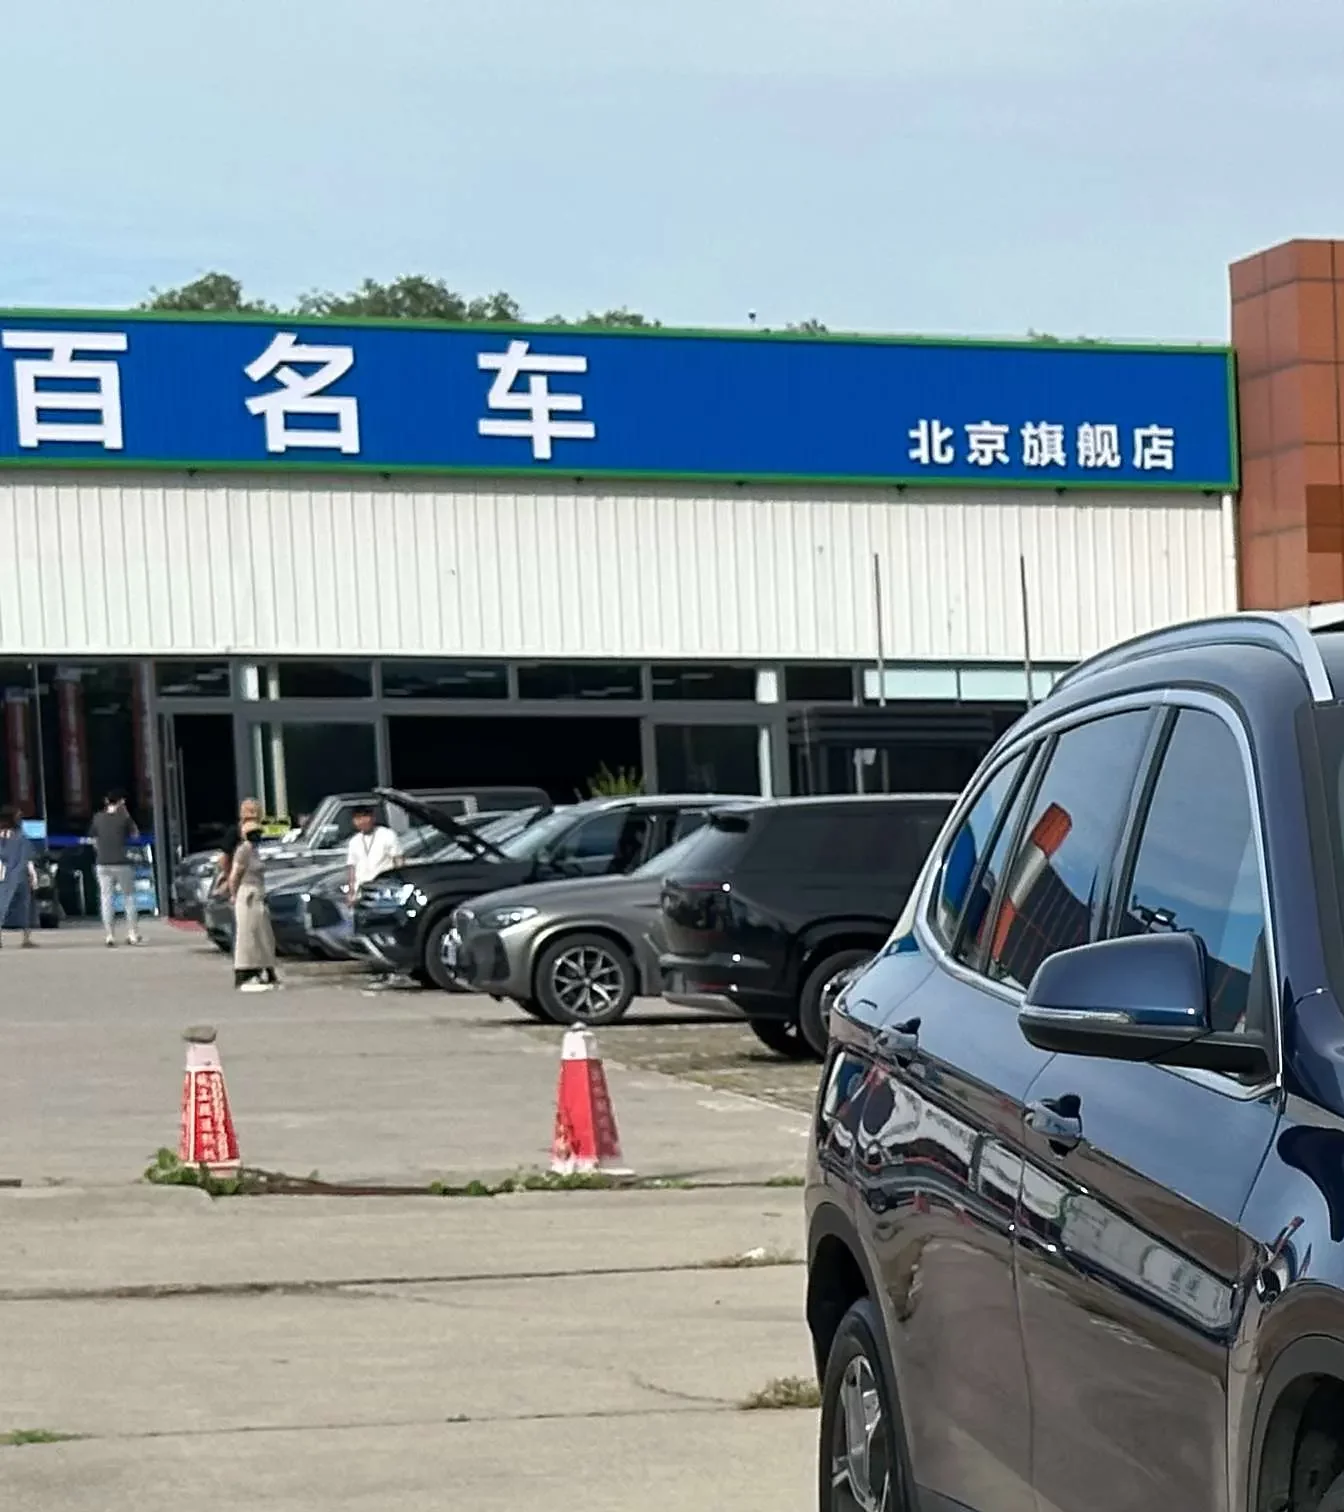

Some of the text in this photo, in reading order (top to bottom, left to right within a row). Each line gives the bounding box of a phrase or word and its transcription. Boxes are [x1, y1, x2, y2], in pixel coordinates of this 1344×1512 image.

[2, 330, 596, 459] 百名车
[908, 419, 1176, 471] 北京旗舰店
